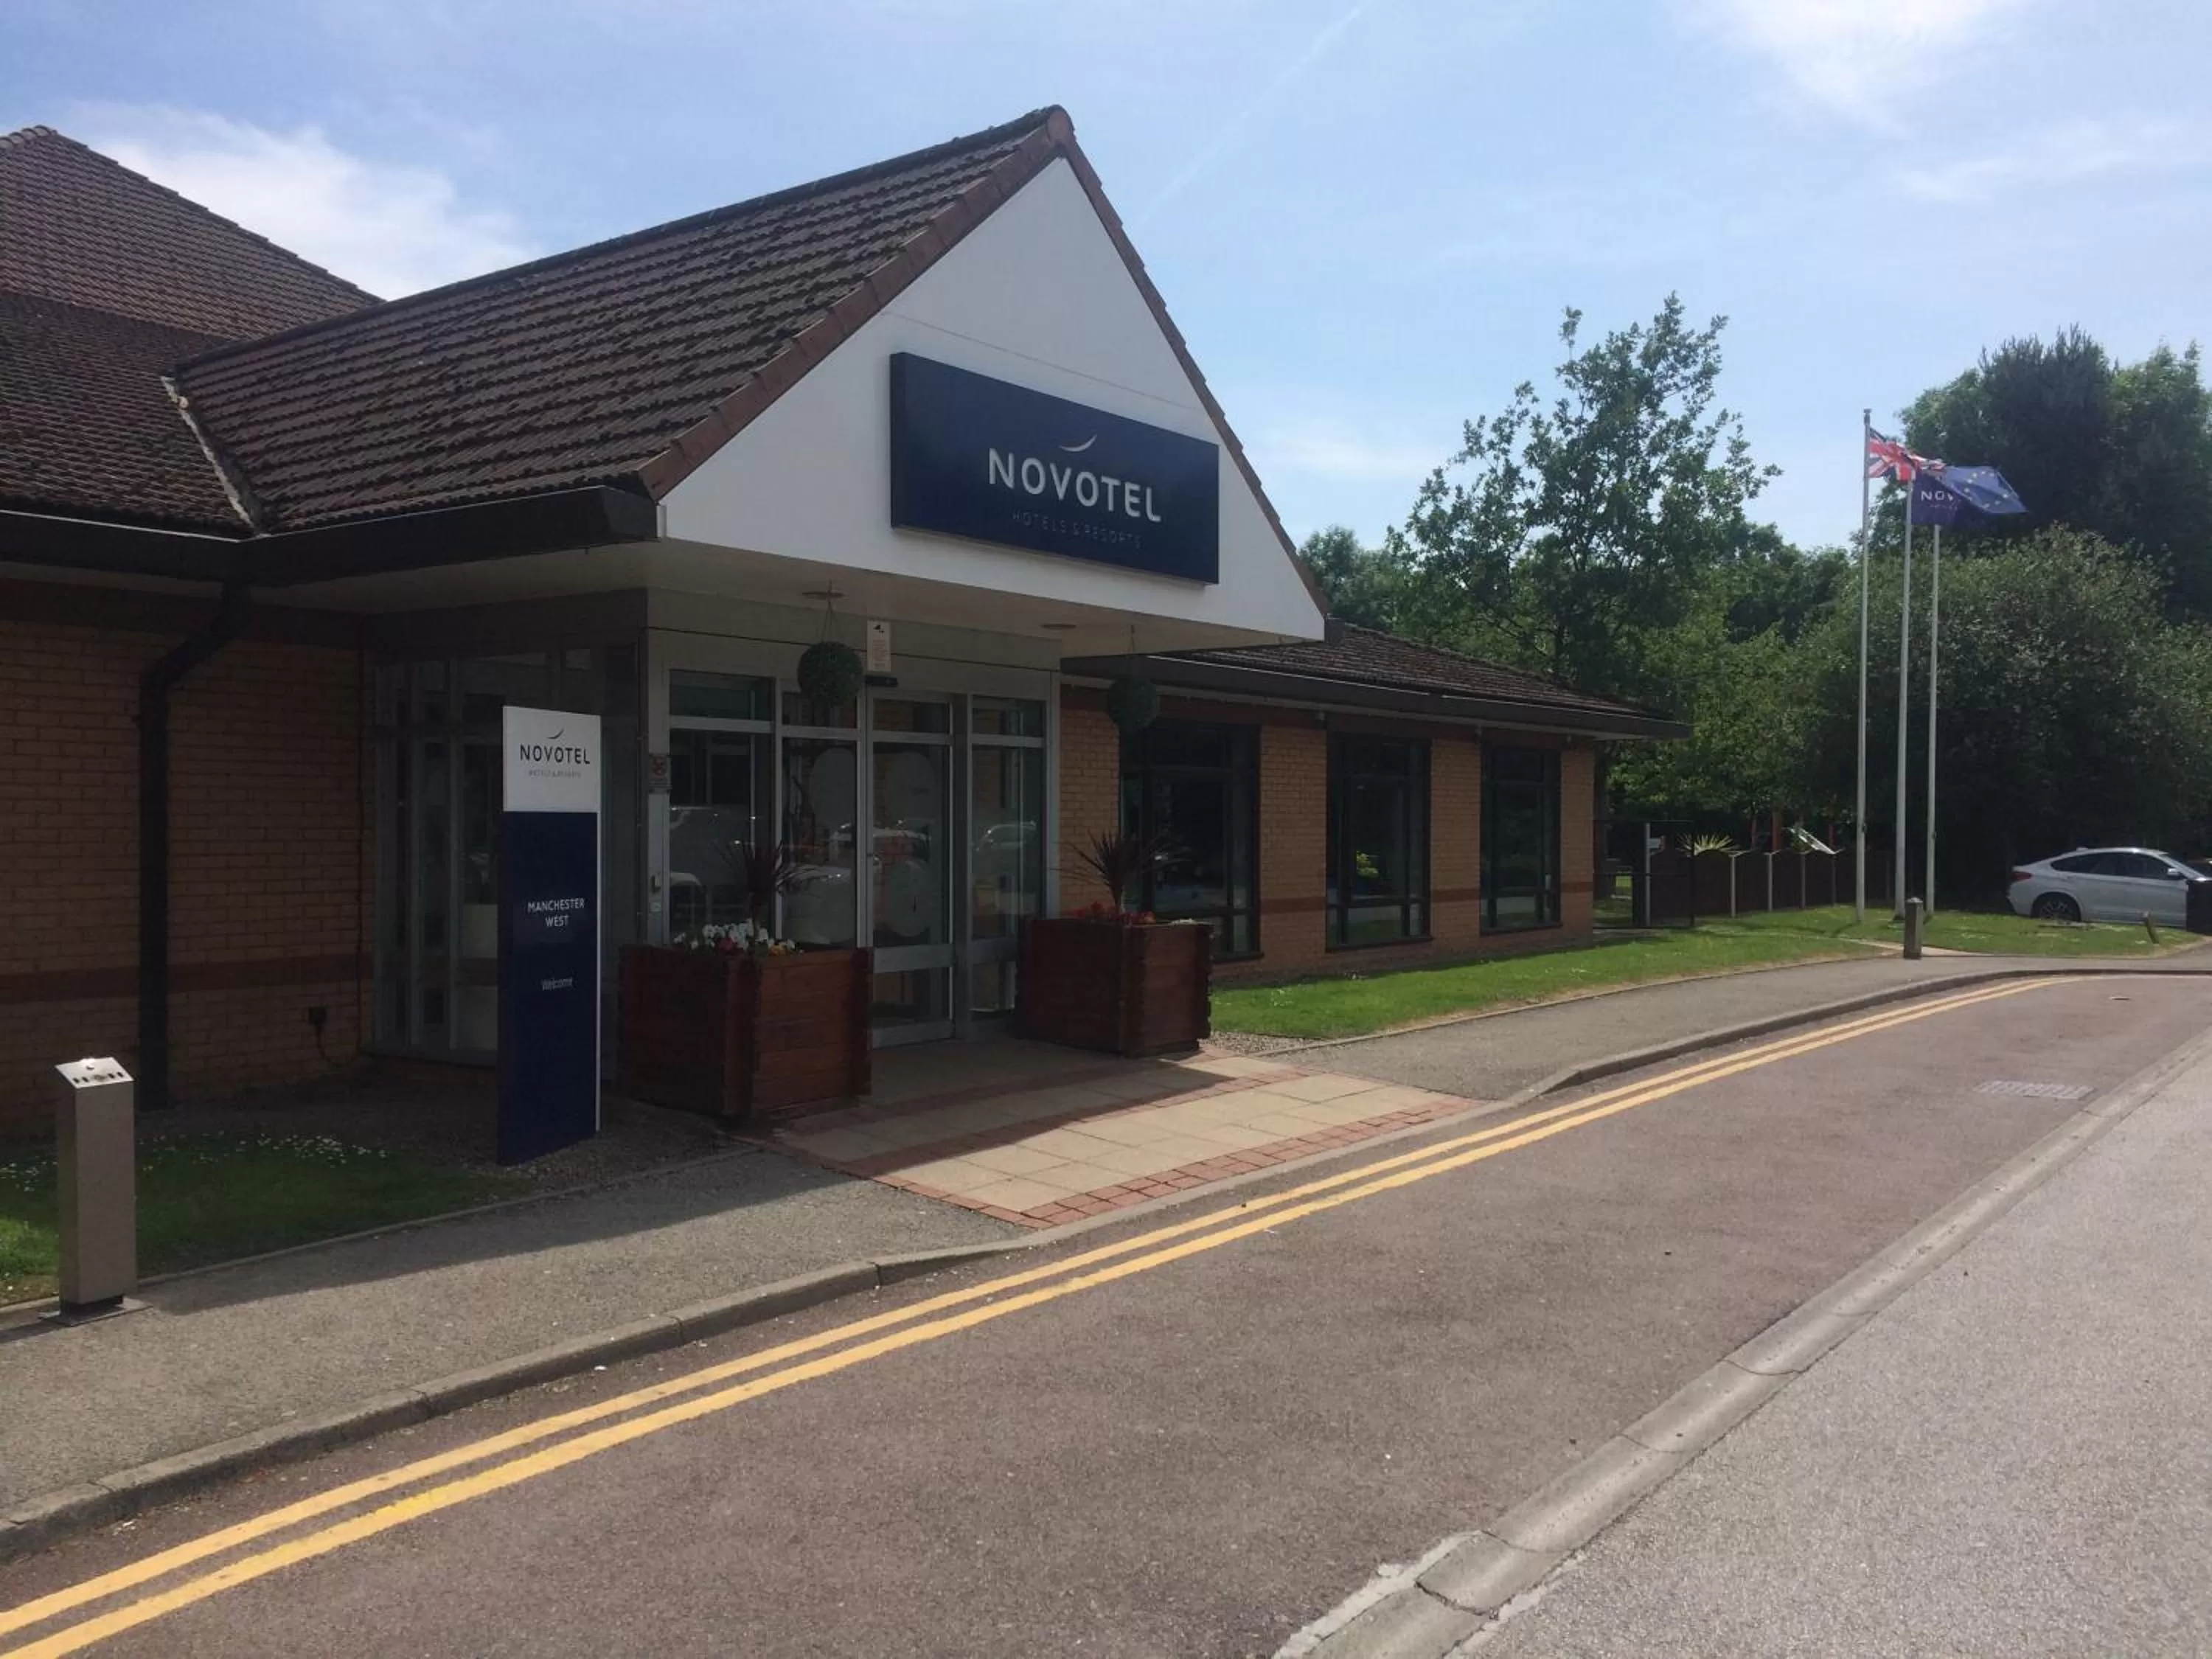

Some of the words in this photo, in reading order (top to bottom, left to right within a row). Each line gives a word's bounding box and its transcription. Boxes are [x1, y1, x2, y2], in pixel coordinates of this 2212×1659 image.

[989, 448, 1161, 522] NOVOTEL
[520, 742, 591, 765] NOVOTEL
[528, 898, 585, 913] MANCHESTER
[545, 914, 569, 928] WEST
